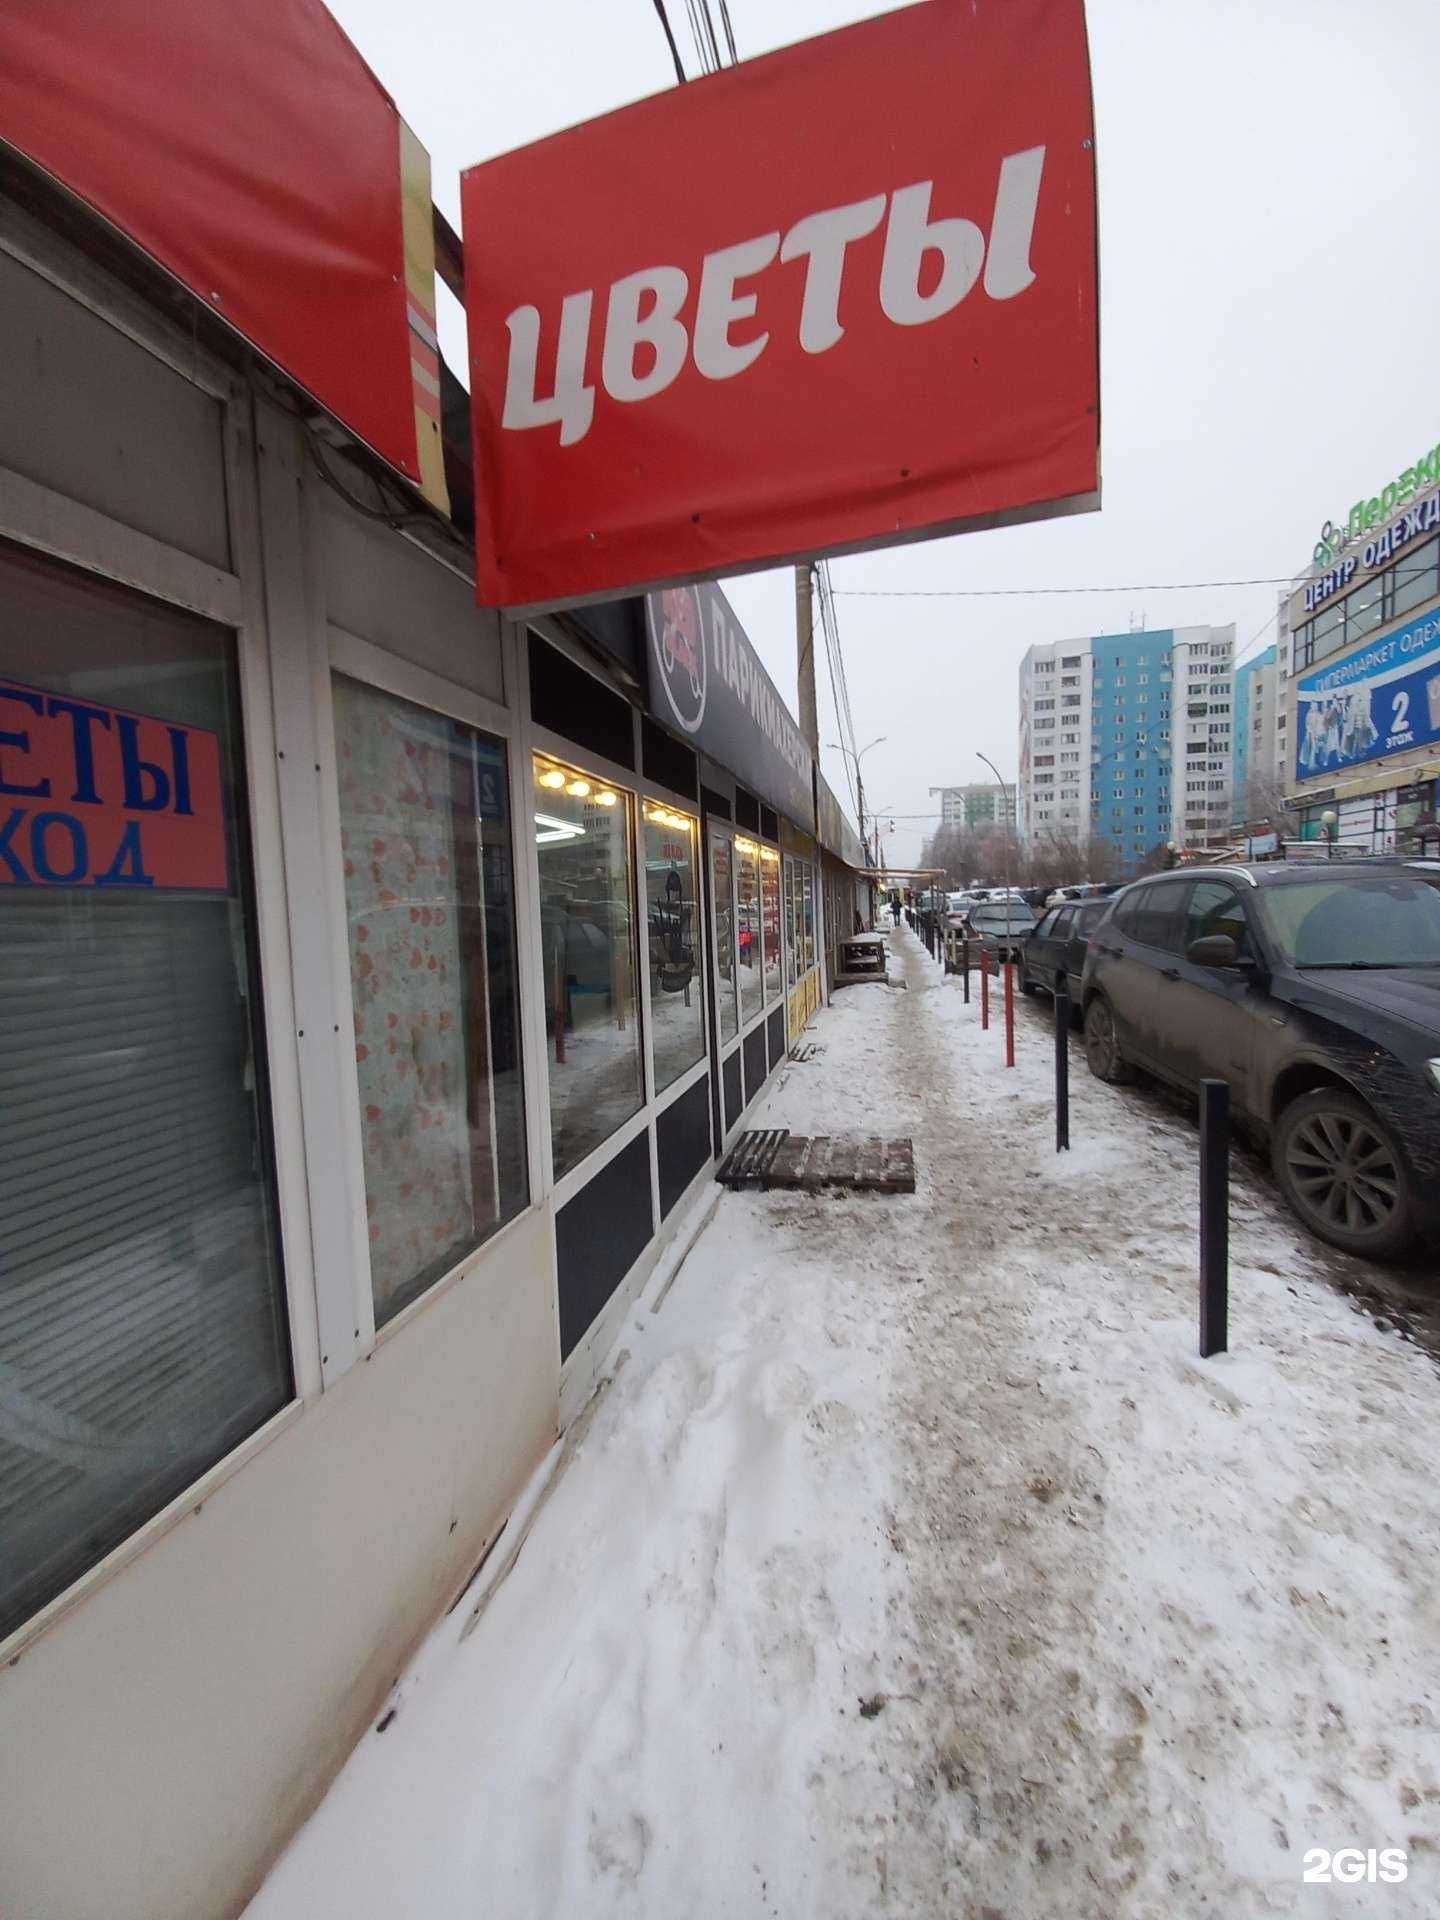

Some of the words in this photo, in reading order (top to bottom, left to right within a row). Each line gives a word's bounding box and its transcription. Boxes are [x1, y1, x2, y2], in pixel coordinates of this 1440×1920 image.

[502, 145, 1046, 447] ЦВЕТЫ
[1304, 556, 1357, 612] ЦЕНТР
[1392, 691, 1409, 733] 2
